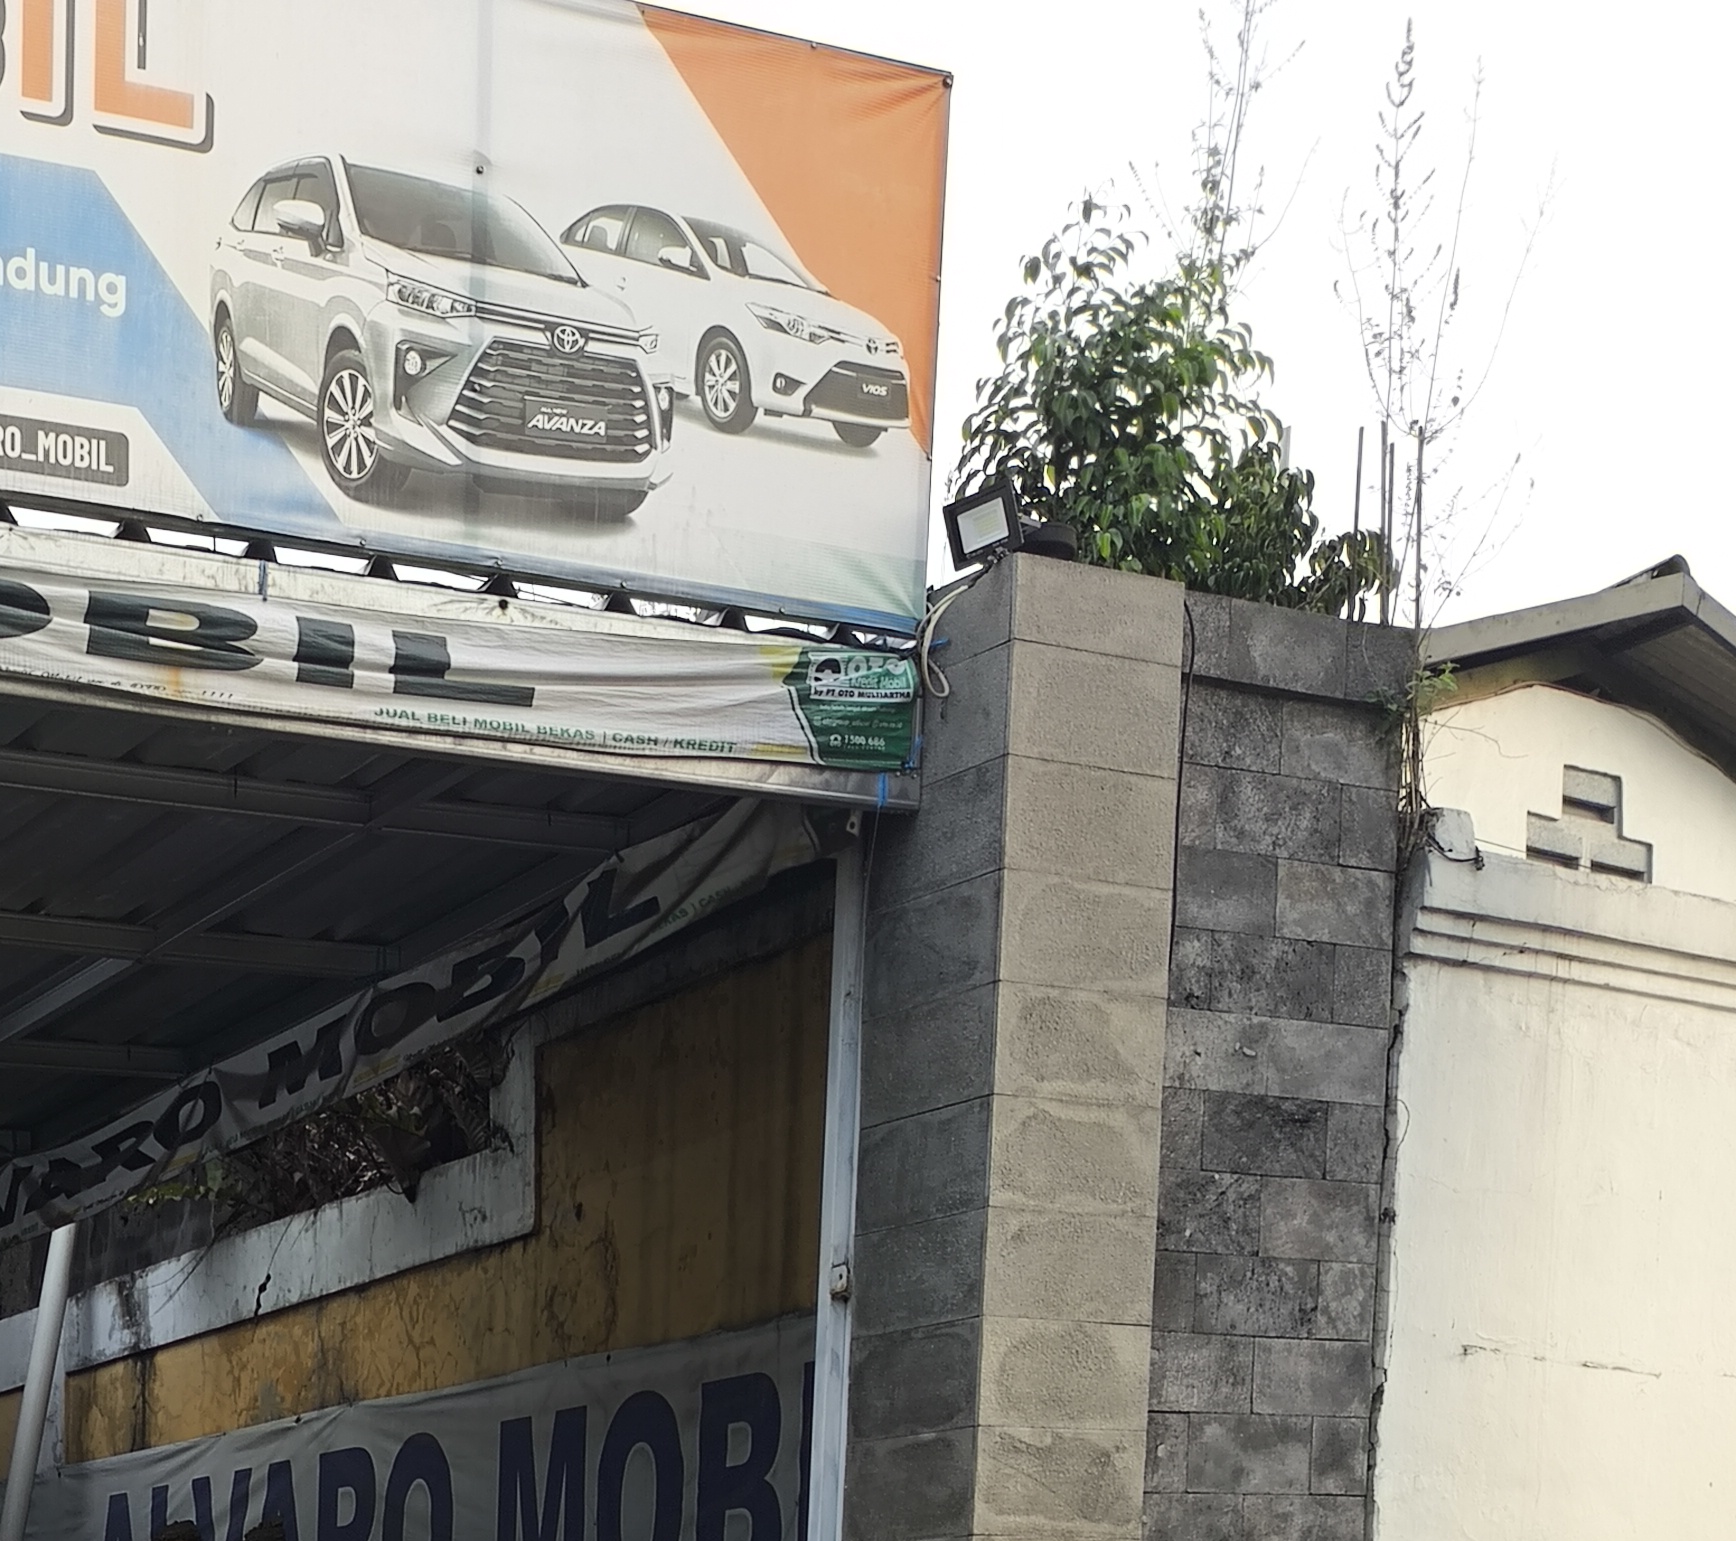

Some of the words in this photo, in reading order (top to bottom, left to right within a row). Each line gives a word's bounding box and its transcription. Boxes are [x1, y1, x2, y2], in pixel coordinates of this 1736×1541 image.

[861, 382, 888, 397] VIOS
[527, 413, 606, 437] AVANZA
[374, 708, 421, 722] JUAL
[427, 712, 467, 727] BELI
[473, 718, 530, 734] MOBIL
[537, 725, 595, 741] BEKAS
[612, 733, 659, 748] CASH
[673, 738, 737, 754] KREDIT
